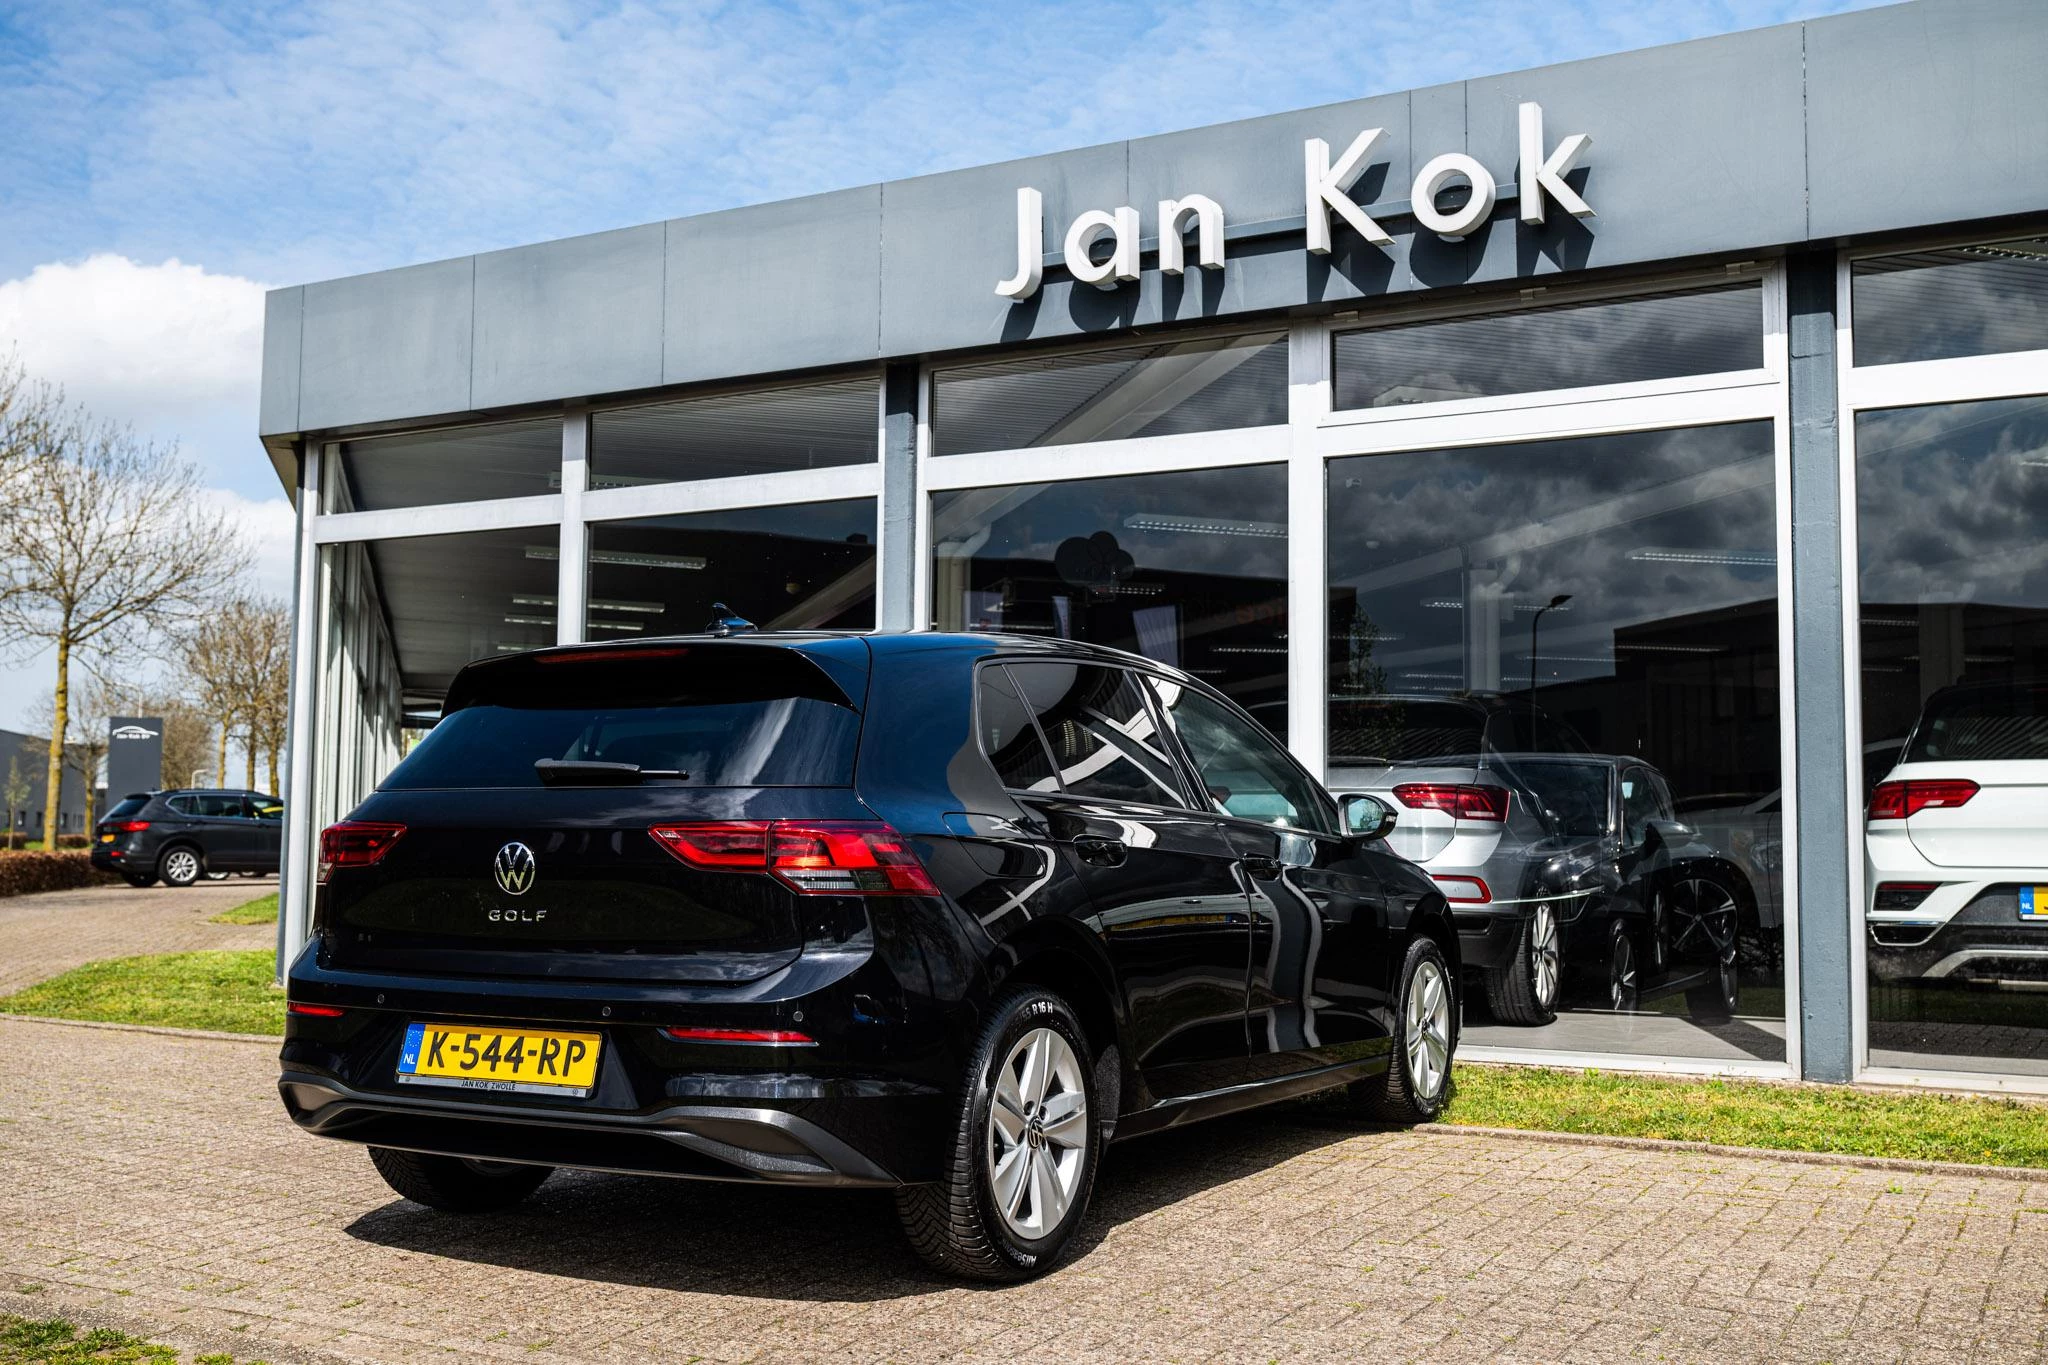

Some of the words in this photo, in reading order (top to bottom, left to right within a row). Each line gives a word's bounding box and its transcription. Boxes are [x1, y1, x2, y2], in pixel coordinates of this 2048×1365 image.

[995, 186, 1225, 300] Jan
[1304, 102, 1598, 256] Kok
[2021, 902, 2032, 910] NL
[488, 909, 547, 922] GOLF
[403, 1053, 416, 1065] NL
[427, 1031, 587, 1077] K-544-RP
[475, 1080, 489, 1088] KOK
[491, 1082, 516, 1091] ZWOLLE
